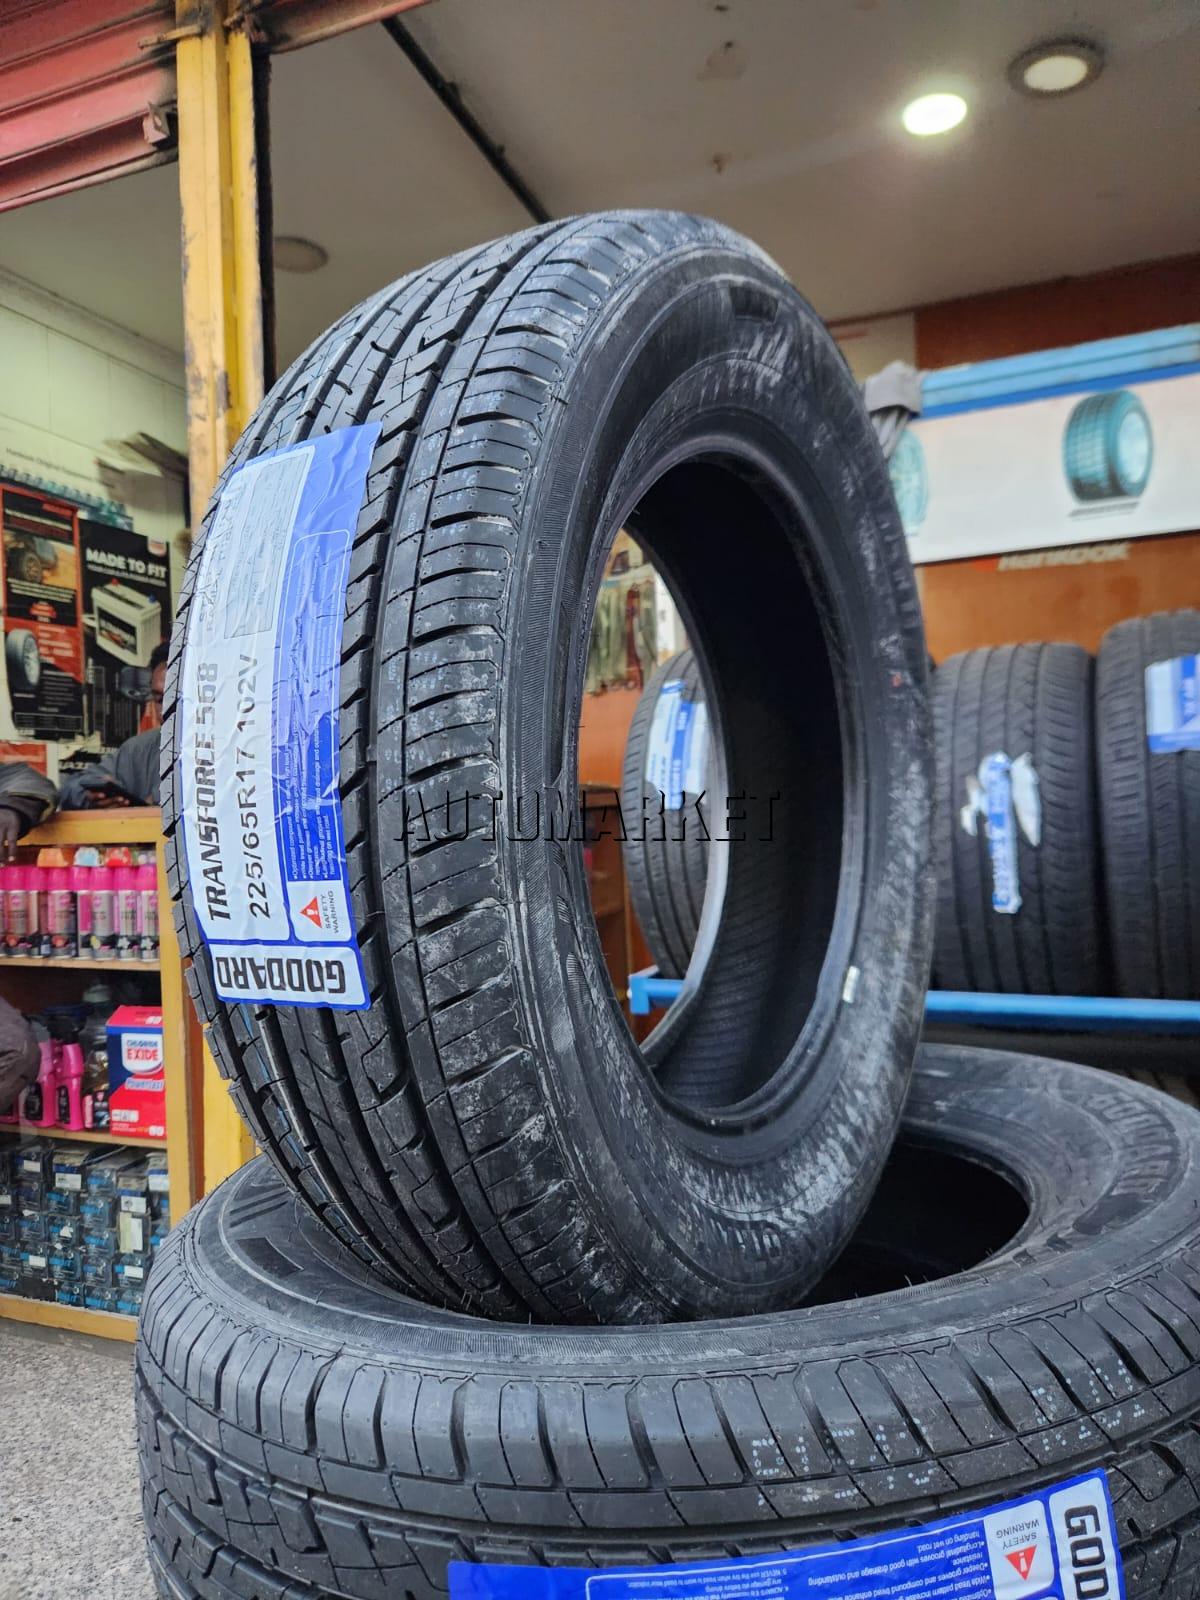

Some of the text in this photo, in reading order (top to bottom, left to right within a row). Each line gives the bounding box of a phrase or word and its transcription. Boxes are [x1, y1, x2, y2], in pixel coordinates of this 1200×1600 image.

[86, 547, 127, 569] MADE
[127, 557, 146, 574] TO
[147, 562, 167, 578] FIT
[195, 663, 231, 920] TRANSFORCE 568
[236, 654, 270, 918] 225/65R17 102V
[321, 894, 332, 929] SAFETY
[328, 890, 339, 934] WARNING
[216, 957, 346, 994] GODDARD
[127, 1049, 158, 1061] EXIDE
[996, 1519, 1039, 1538] WARNING
[945, 1538, 953, 1546] on
[954, 1531, 979, 1542] handling
[1002, 1532, 1037, 1549] SAFETY
[933, 1541, 944, 1549] wet
[808, 1541, 981, 1586] Longitudinal grooves with good drainage and outstanding
[963, 1563, 985, 1574] Deeper
[924, 1576, 936, 1585] and
[938, 1567, 962, 1581] grooves
[971, 1575, 987, 1585] Wide
[873, 1587, 890, 1597] tread
[891, 1580, 923, 1593] compound
[932, 1583, 953, 1596] pattern
[954, 1580, 971, 1591] tread
